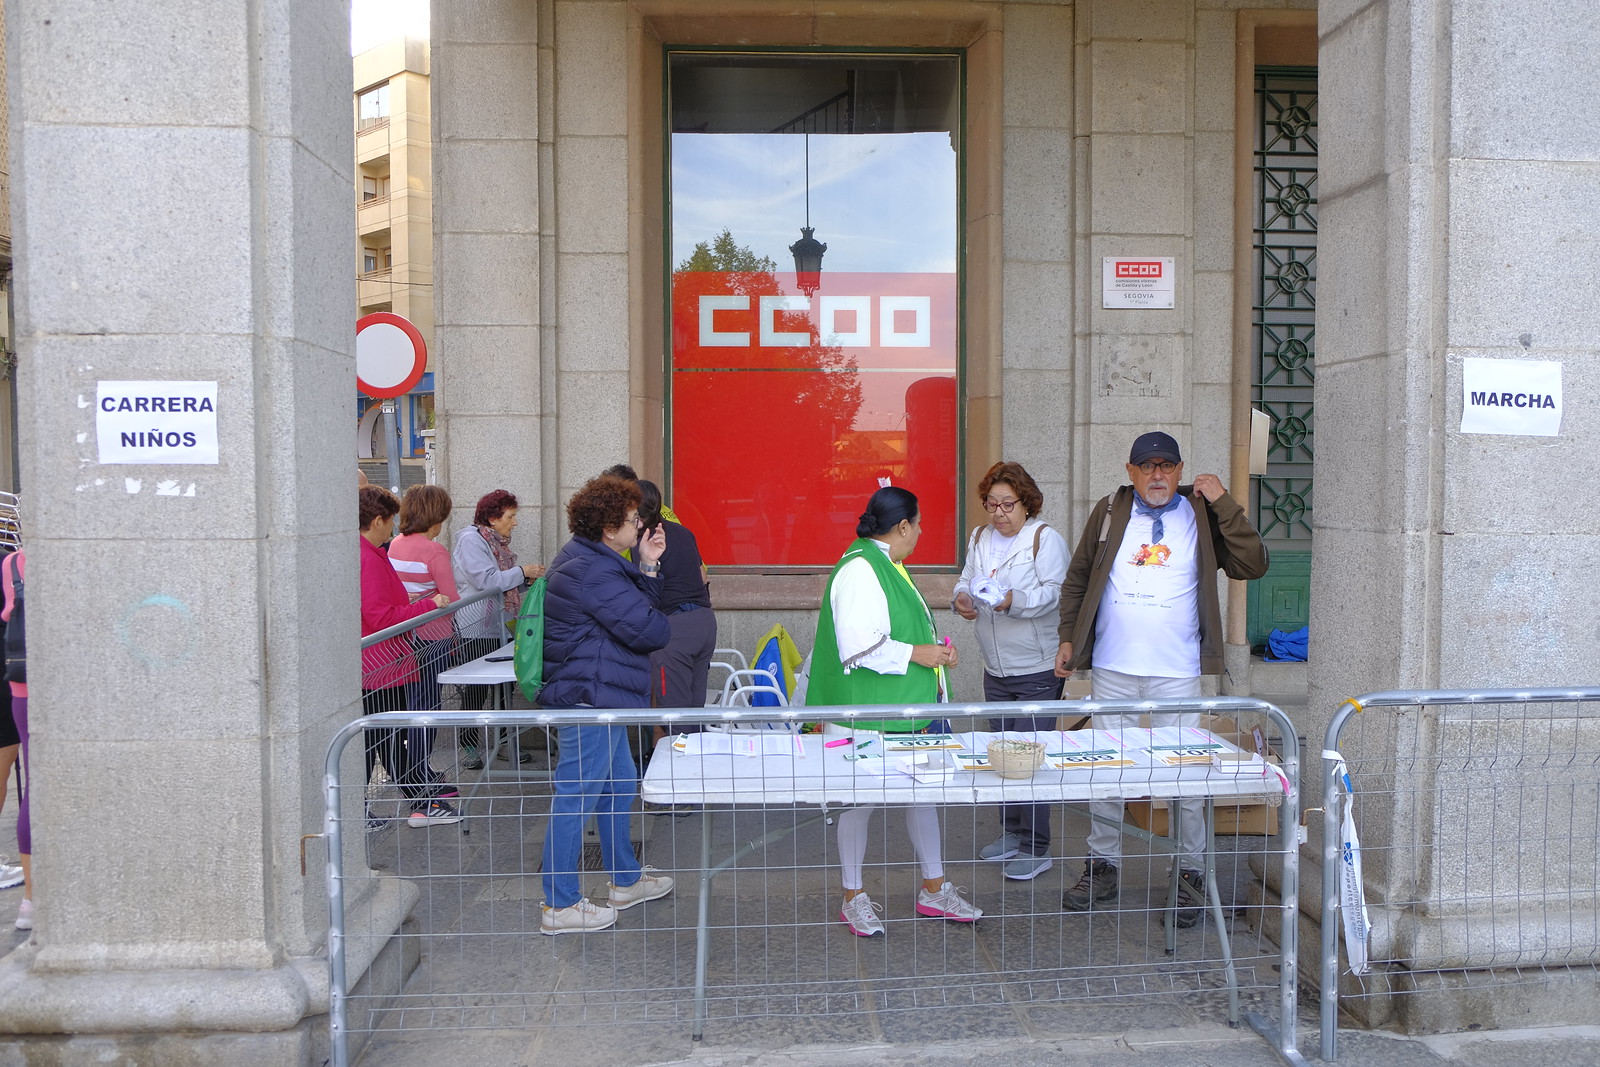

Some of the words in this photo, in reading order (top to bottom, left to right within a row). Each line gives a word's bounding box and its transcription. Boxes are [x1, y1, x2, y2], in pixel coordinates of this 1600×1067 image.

[1119, 264, 1159, 275] CCOO
[699, 295, 930, 348] CCOO
[101, 397, 214, 412] CARRERA
[1471, 391, 1556, 409] MARCHA
[120, 428, 197, 448] NIÑOS
